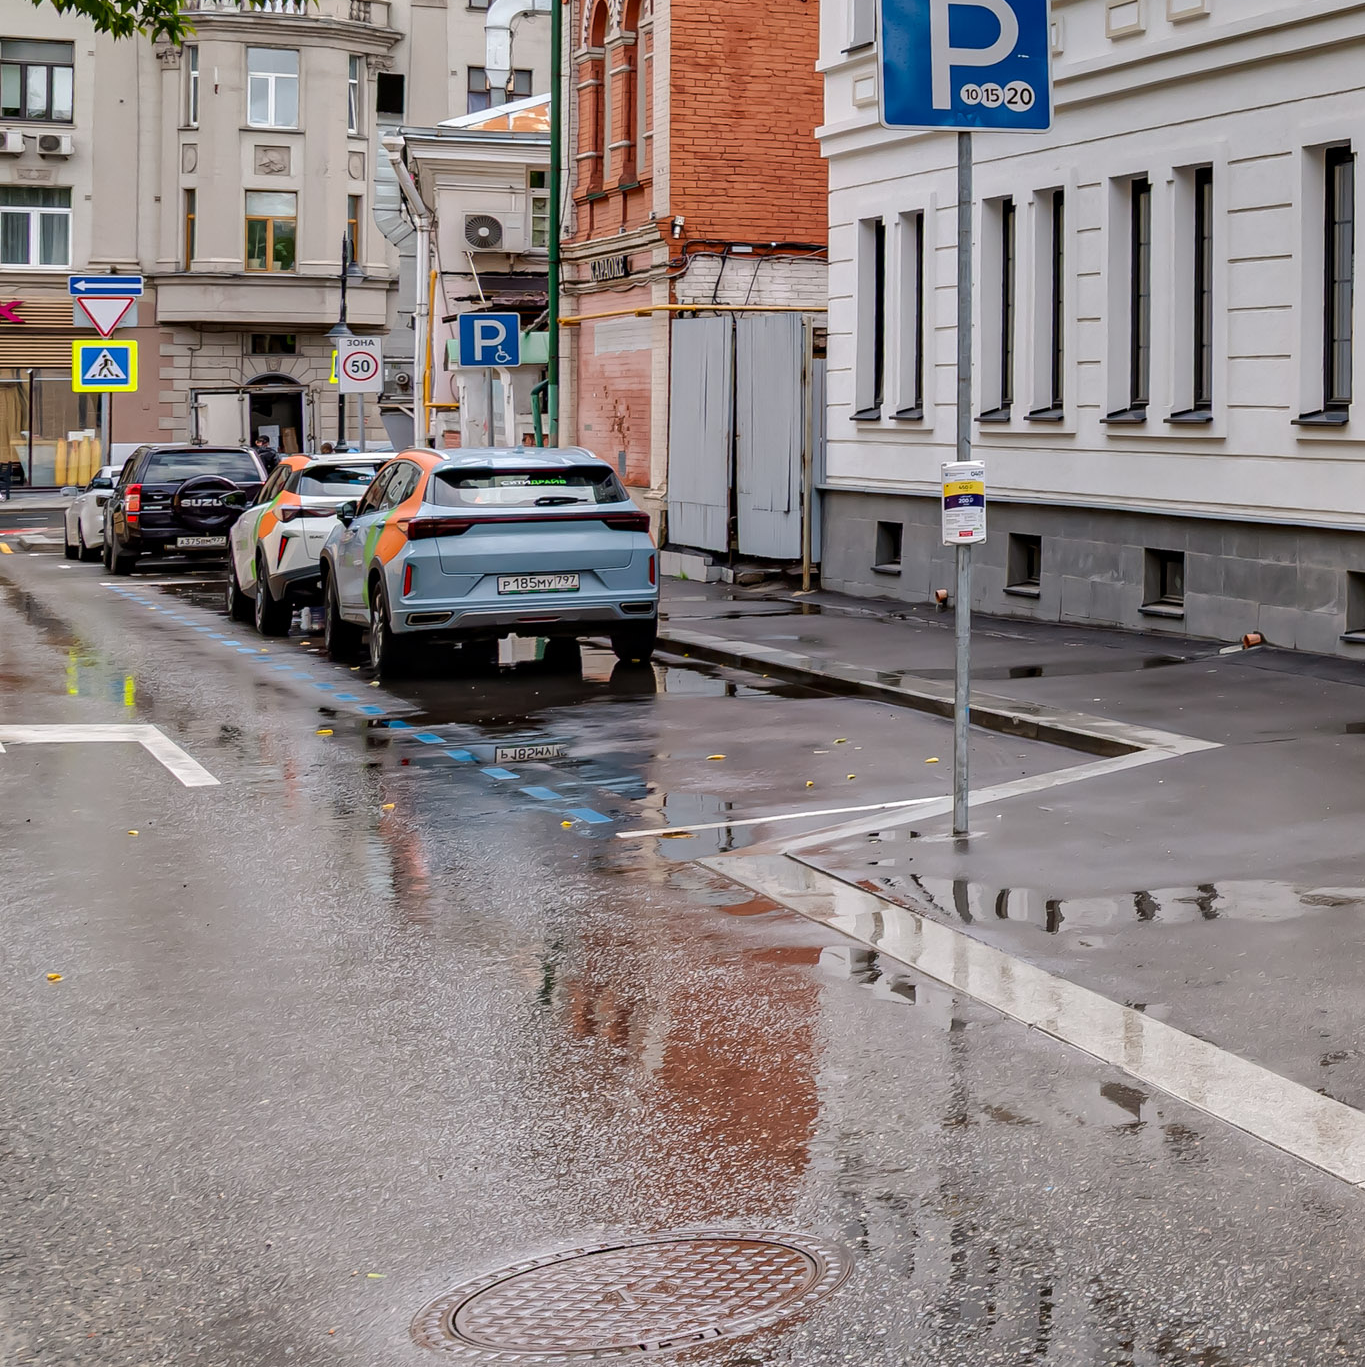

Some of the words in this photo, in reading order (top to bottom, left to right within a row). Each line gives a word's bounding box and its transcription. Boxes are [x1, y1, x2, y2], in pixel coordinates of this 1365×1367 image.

[965, 89, 979, 100] 10
[984, 89, 1000, 102] 15
[1007, 87, 1032, 105] 20
[590, 255, 625, 281] КАРАОКЕ
[346, 339, 376, 347] ЗОНА
[473, 319, 507, 361] P
[351, 359, 371, 374] 50
[180, 498, 223, 507] SUZU
